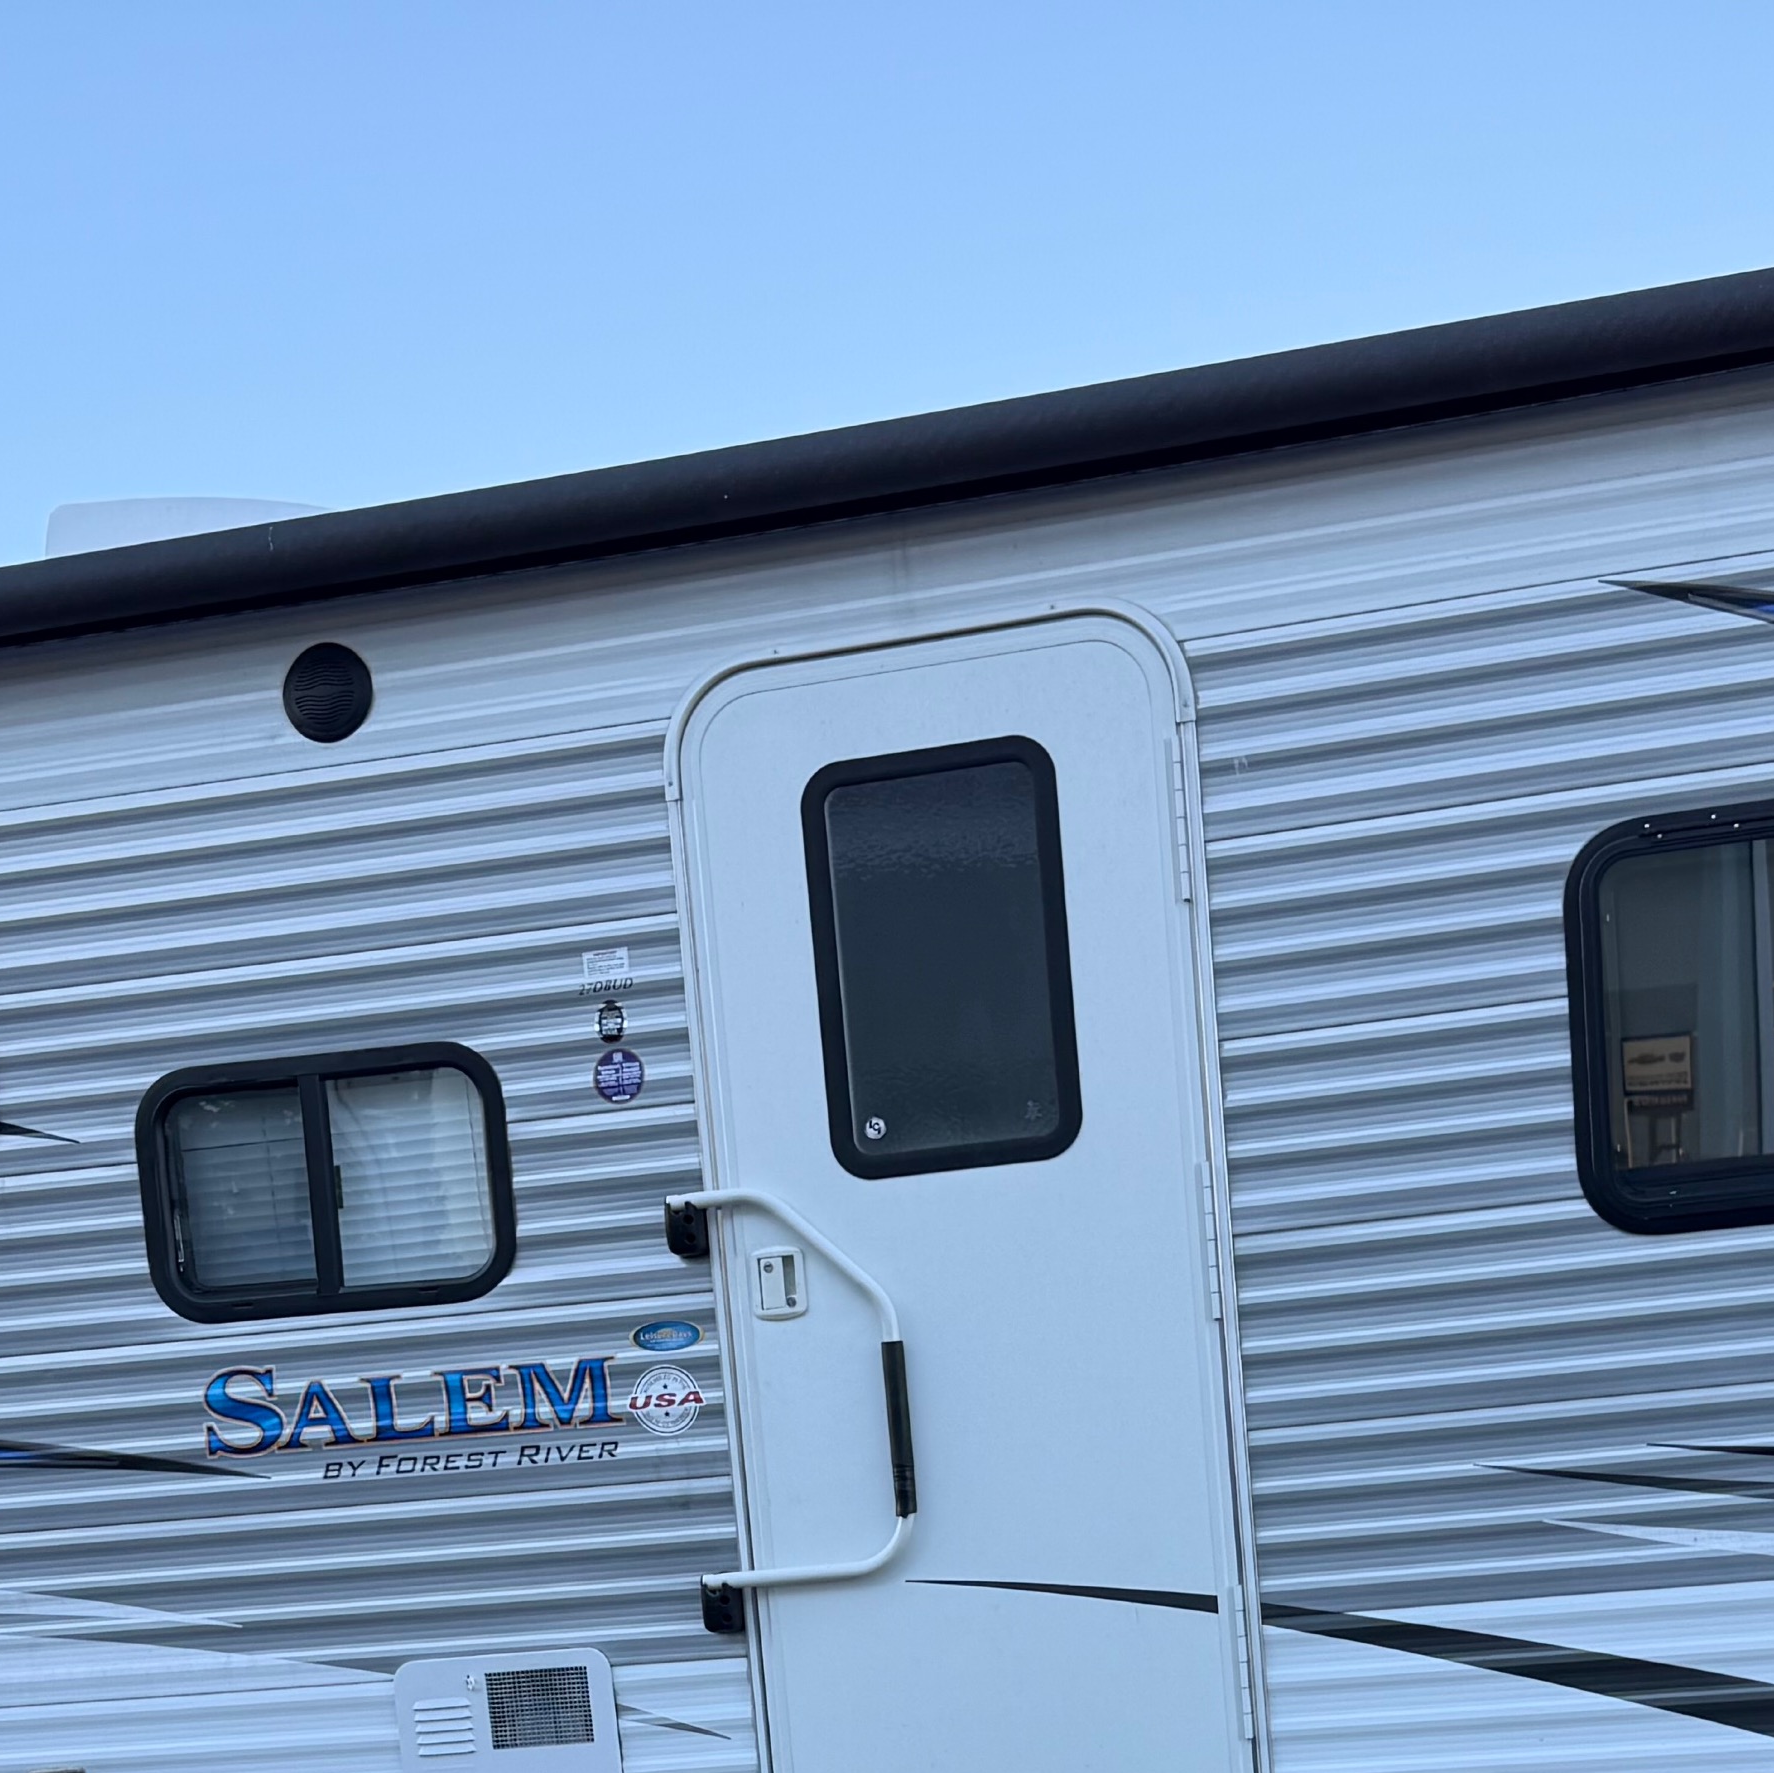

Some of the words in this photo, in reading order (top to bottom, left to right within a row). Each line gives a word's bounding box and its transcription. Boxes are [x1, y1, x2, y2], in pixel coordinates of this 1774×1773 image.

[579, 977, 633, 996] 27DBUD
[204, 1356, 624, 1459] SALEM
[629, 1391, 704, 1411] USA
[324, 1461, 366, 1479] BY
[376, 1453, 506, 1475] FOREST
[517, 1442, 619, 1465] RIVER
